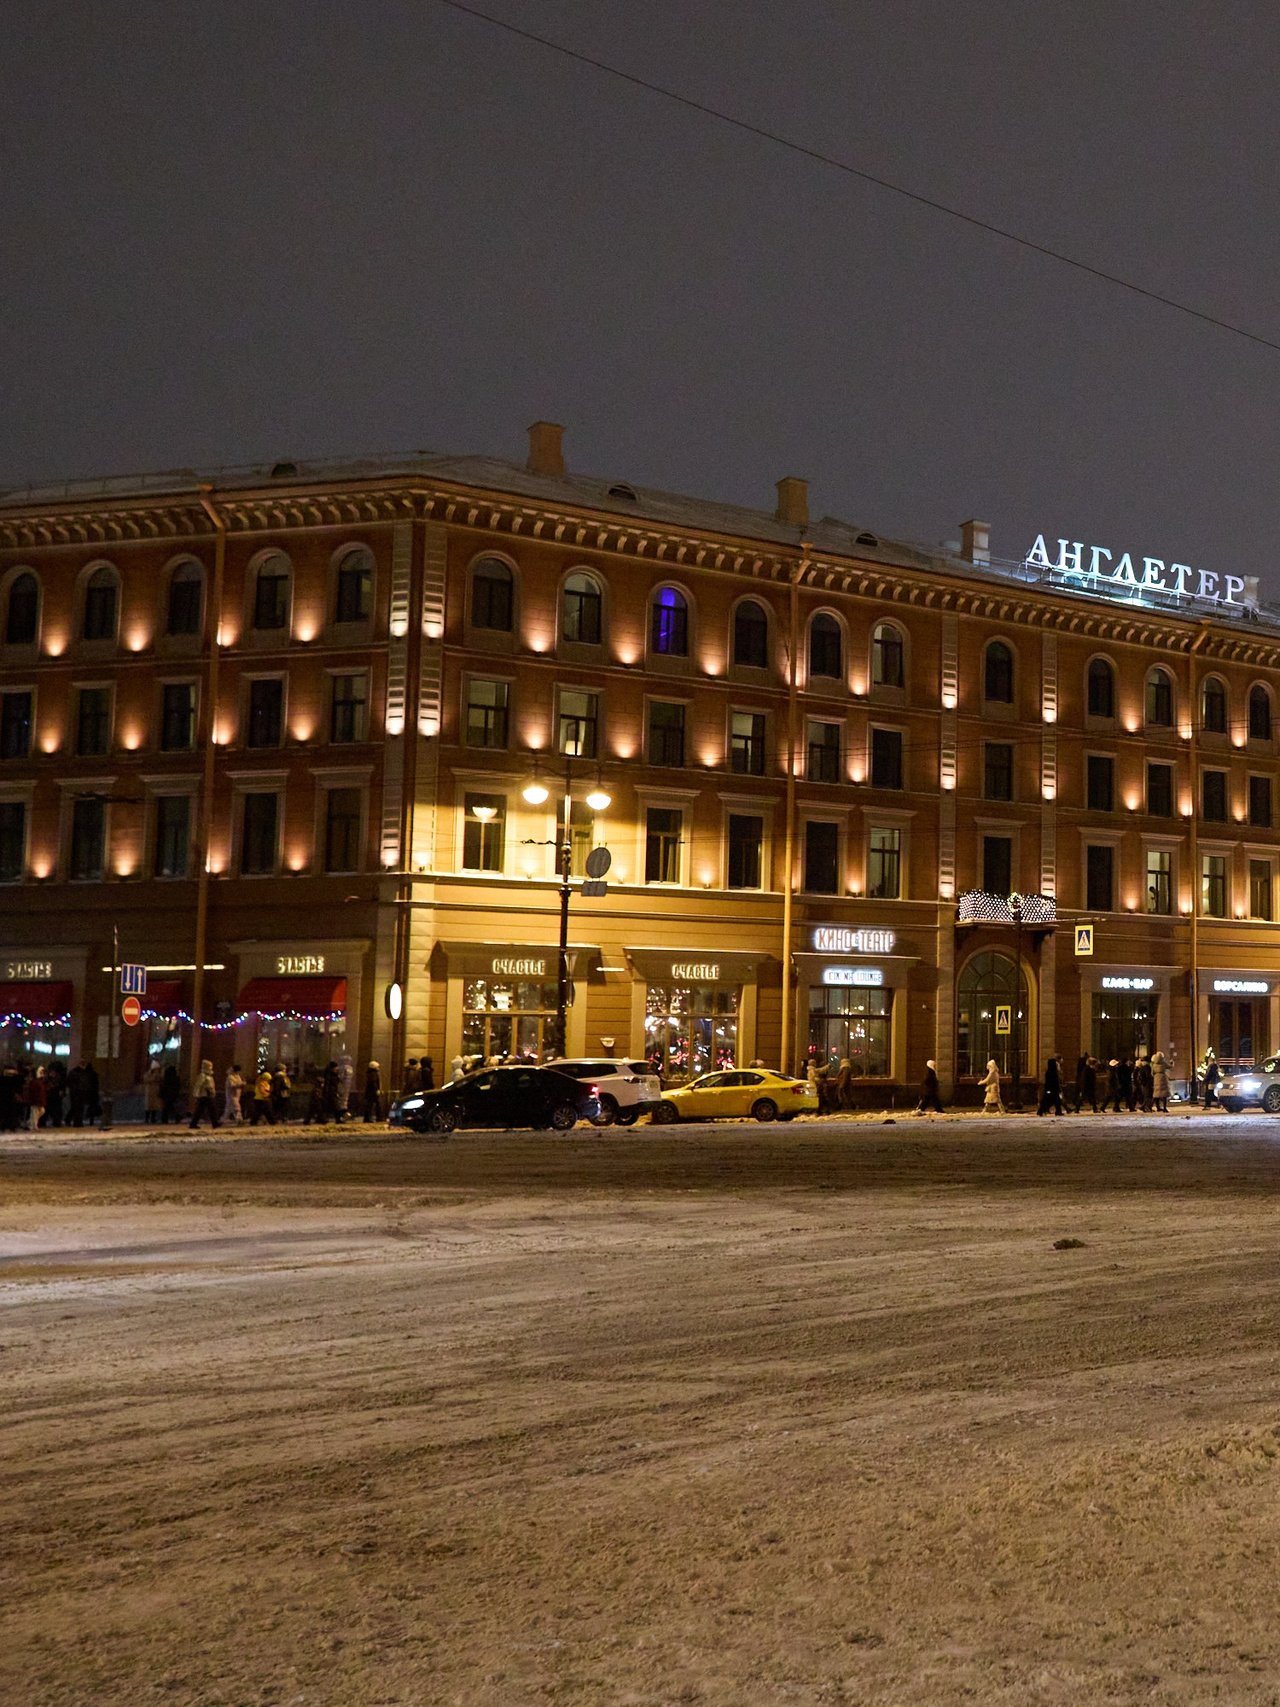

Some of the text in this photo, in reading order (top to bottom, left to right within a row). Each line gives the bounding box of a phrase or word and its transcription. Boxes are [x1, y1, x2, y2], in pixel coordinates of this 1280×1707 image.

[1025, 534, 1246, 605] АНГЛЕТЕР
[492, 958, 547, 976] СЧАСТЬЕ
[671, 963, 720, 980] СЧАСТЬЕ
